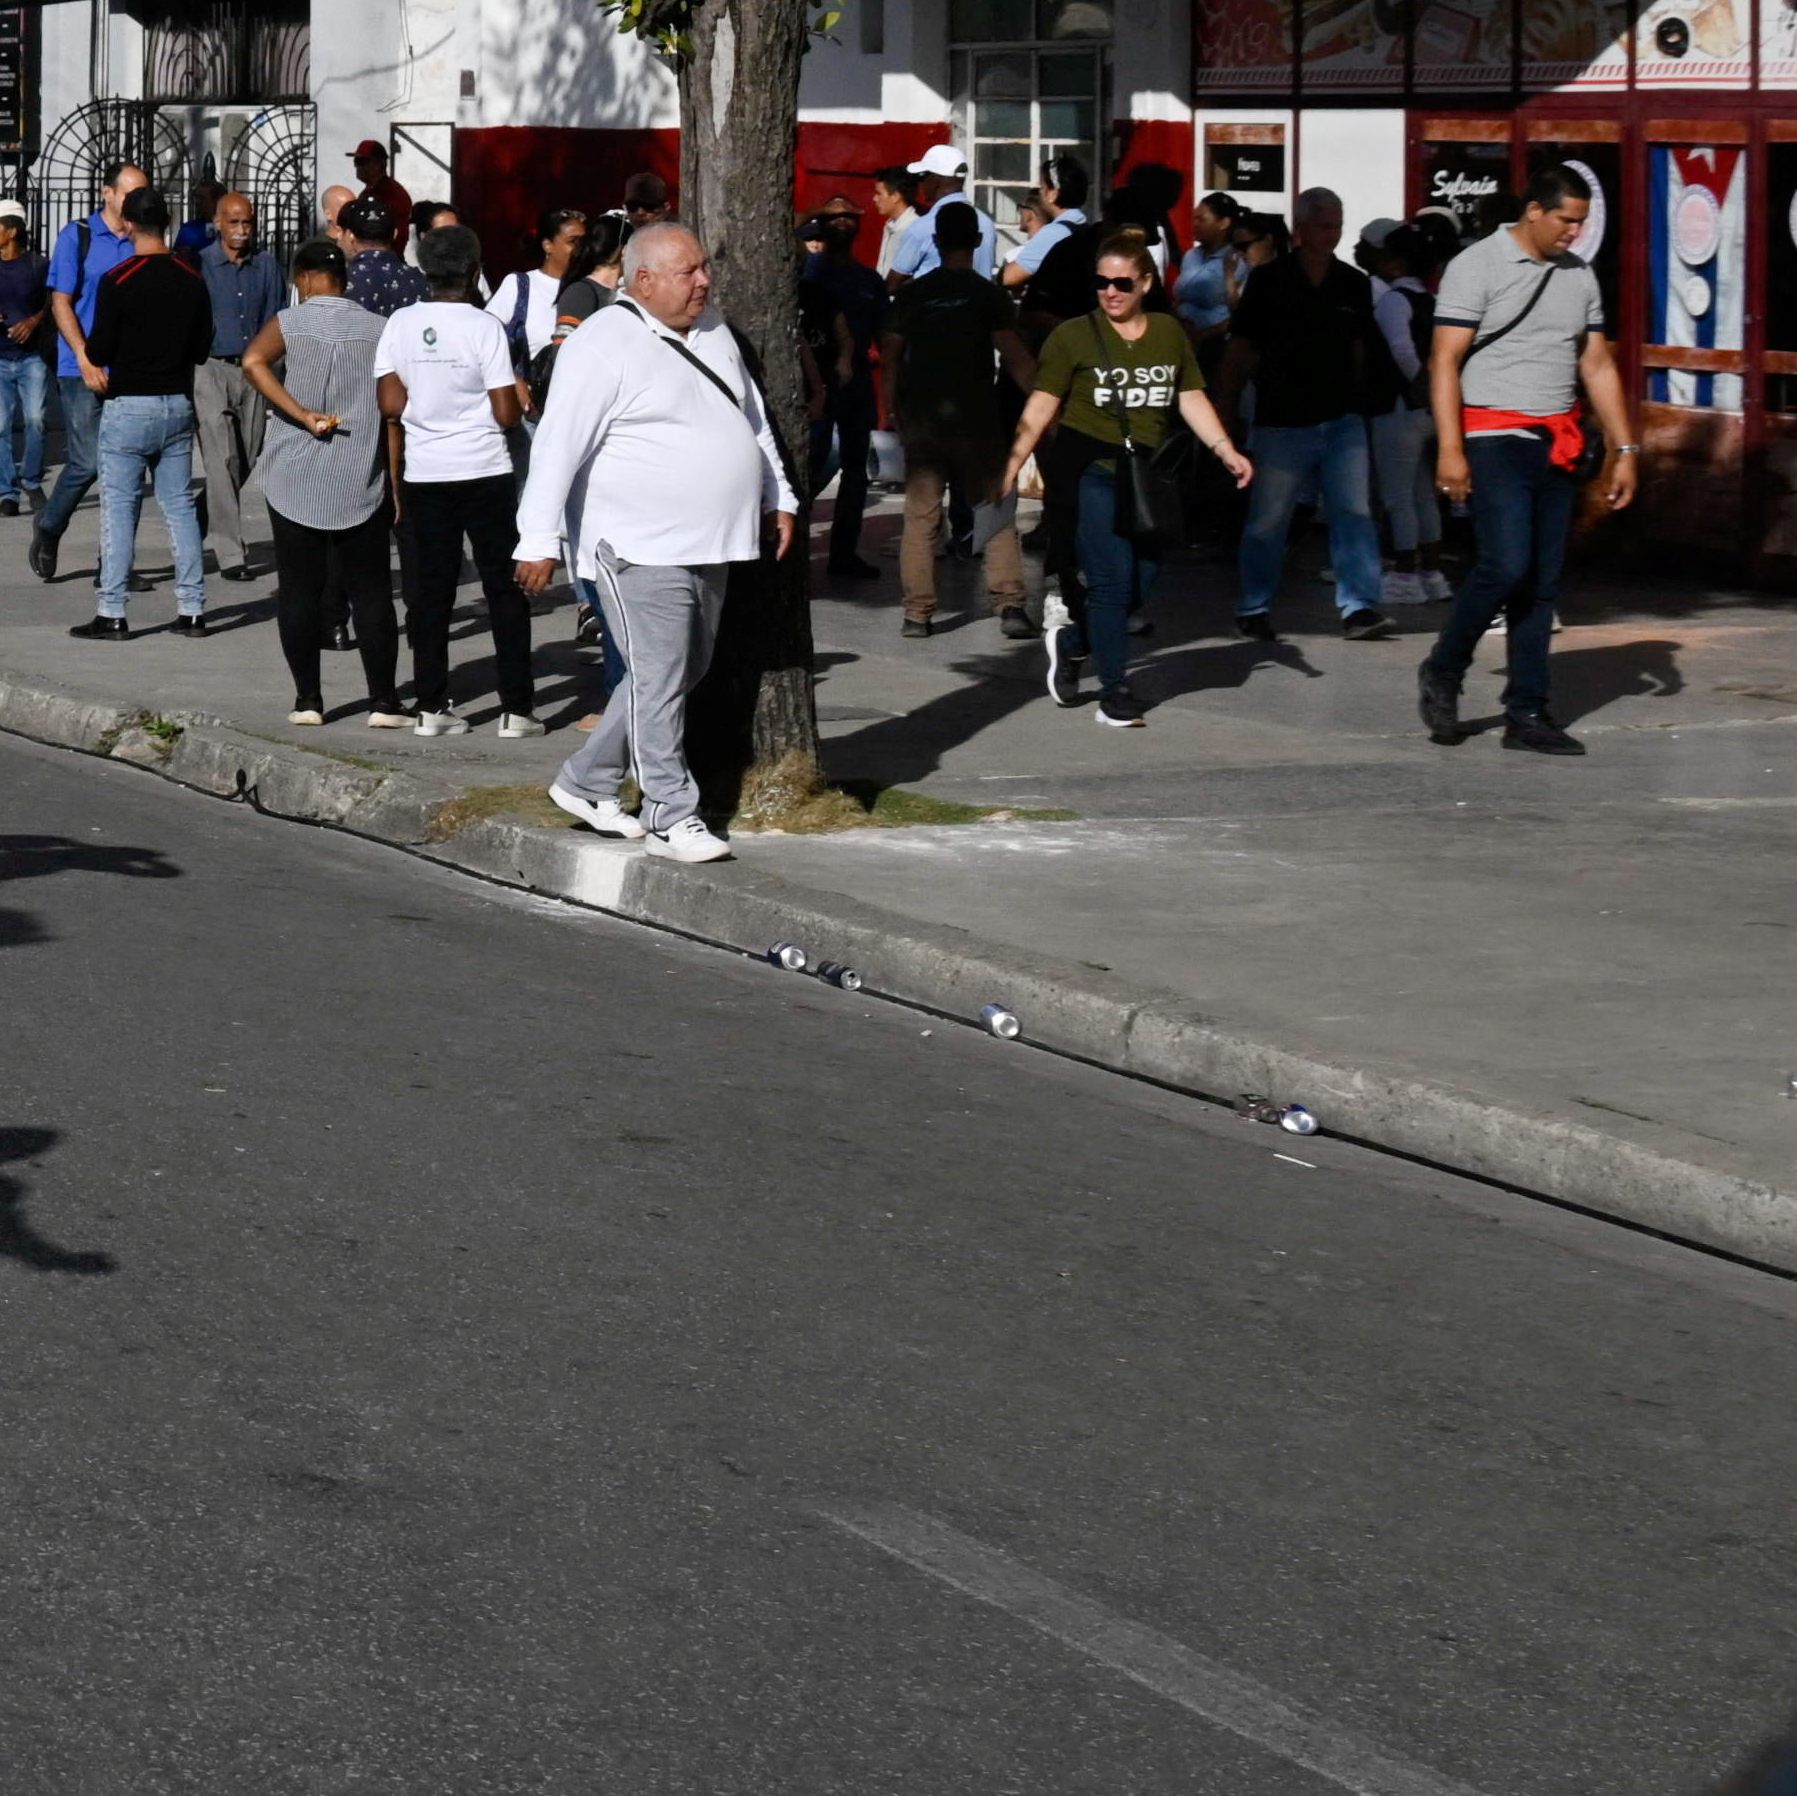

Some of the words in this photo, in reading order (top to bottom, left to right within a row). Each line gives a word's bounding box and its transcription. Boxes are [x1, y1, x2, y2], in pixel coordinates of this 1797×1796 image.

[1430, 169, 1498, 202] Sylvain
[1094, 367, 1129, 386] YO
[1134, 364, 1176, 384] SOY
